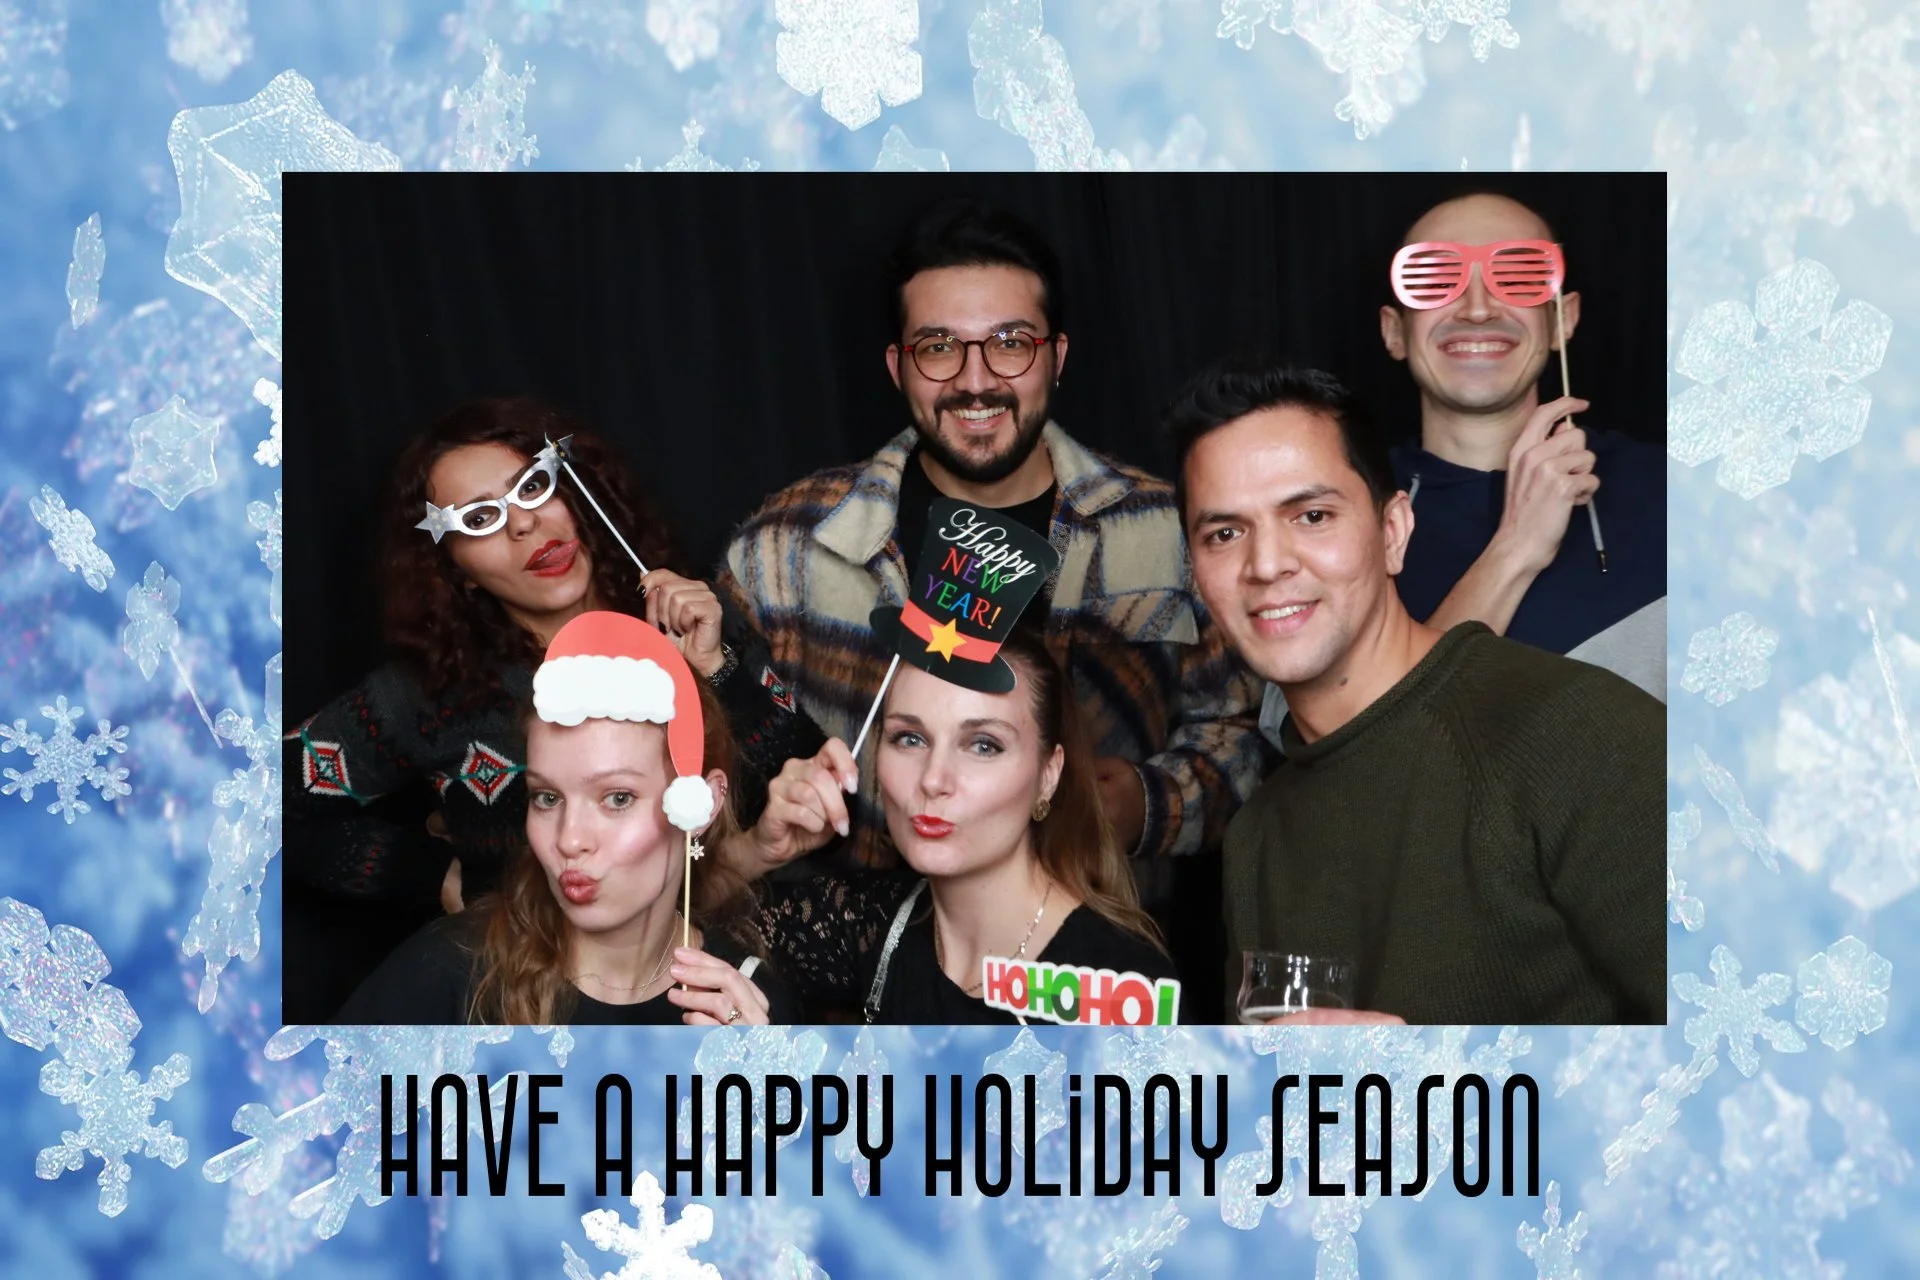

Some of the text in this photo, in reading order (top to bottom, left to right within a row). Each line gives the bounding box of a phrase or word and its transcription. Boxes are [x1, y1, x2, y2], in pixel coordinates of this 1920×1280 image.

[938, 508, 1036, 584] Happy
[941, 547, 1011, 594] NEW
[924, 574, 1002, 630] YEAR!
